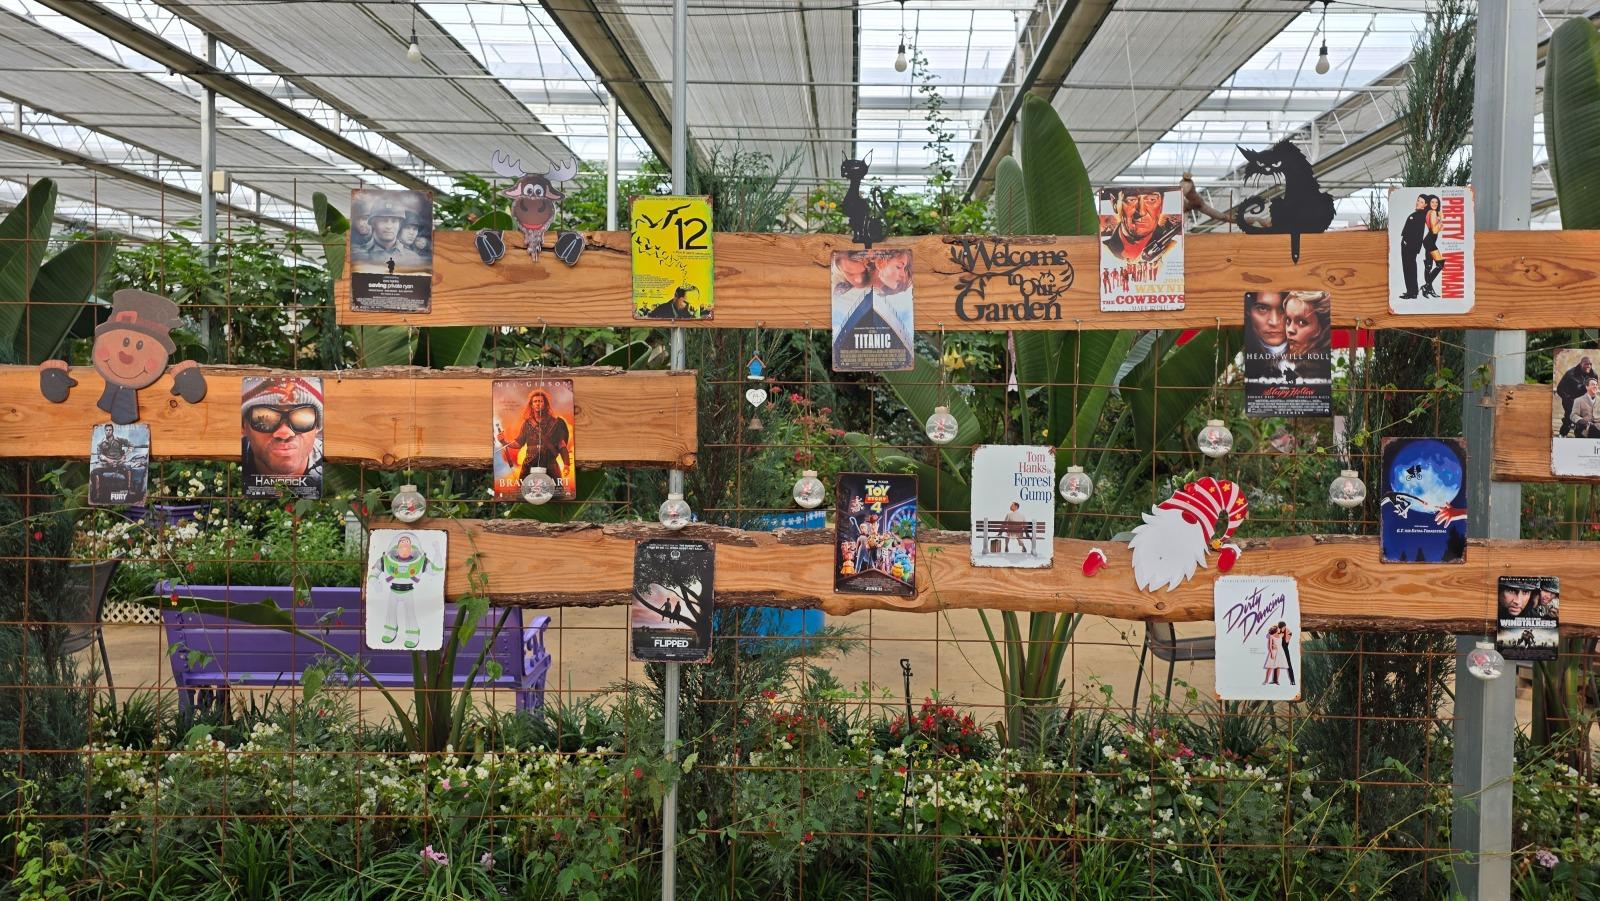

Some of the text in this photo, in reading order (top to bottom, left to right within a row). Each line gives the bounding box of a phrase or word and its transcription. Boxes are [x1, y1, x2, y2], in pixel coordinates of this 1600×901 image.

[1442, 197, 1464, 240] PRETTY
[675, 217, 708, 250] 12
[957, 239, 1068, 272] Welcome
[1442, 251, 1464, 298] WOMAN
[1008, 273, 1056, 297] to Our
[955, 287, 1062, 321] Garden
[1115, 295, 1184, 305] COWBOYS
[854, 333, 891, 349] TITANIC
[1027, 451, 1046, 462] Tom
[1019, 462, 1047, 473] Hanks
[1014, 472, 1052, 487] Forrest
[865, 484, 891, 496] TOY
[1020, 487, 1052, 503] Gump
[870, 501, 882, 513] 4
[1223, 585, 1269, 633] Dirty
[1238, 593, 1285, 643] Dancing
[1500, 619, 1557, 627] WINDTALKERS
[654, 639, 689, 648] FLIPPED
